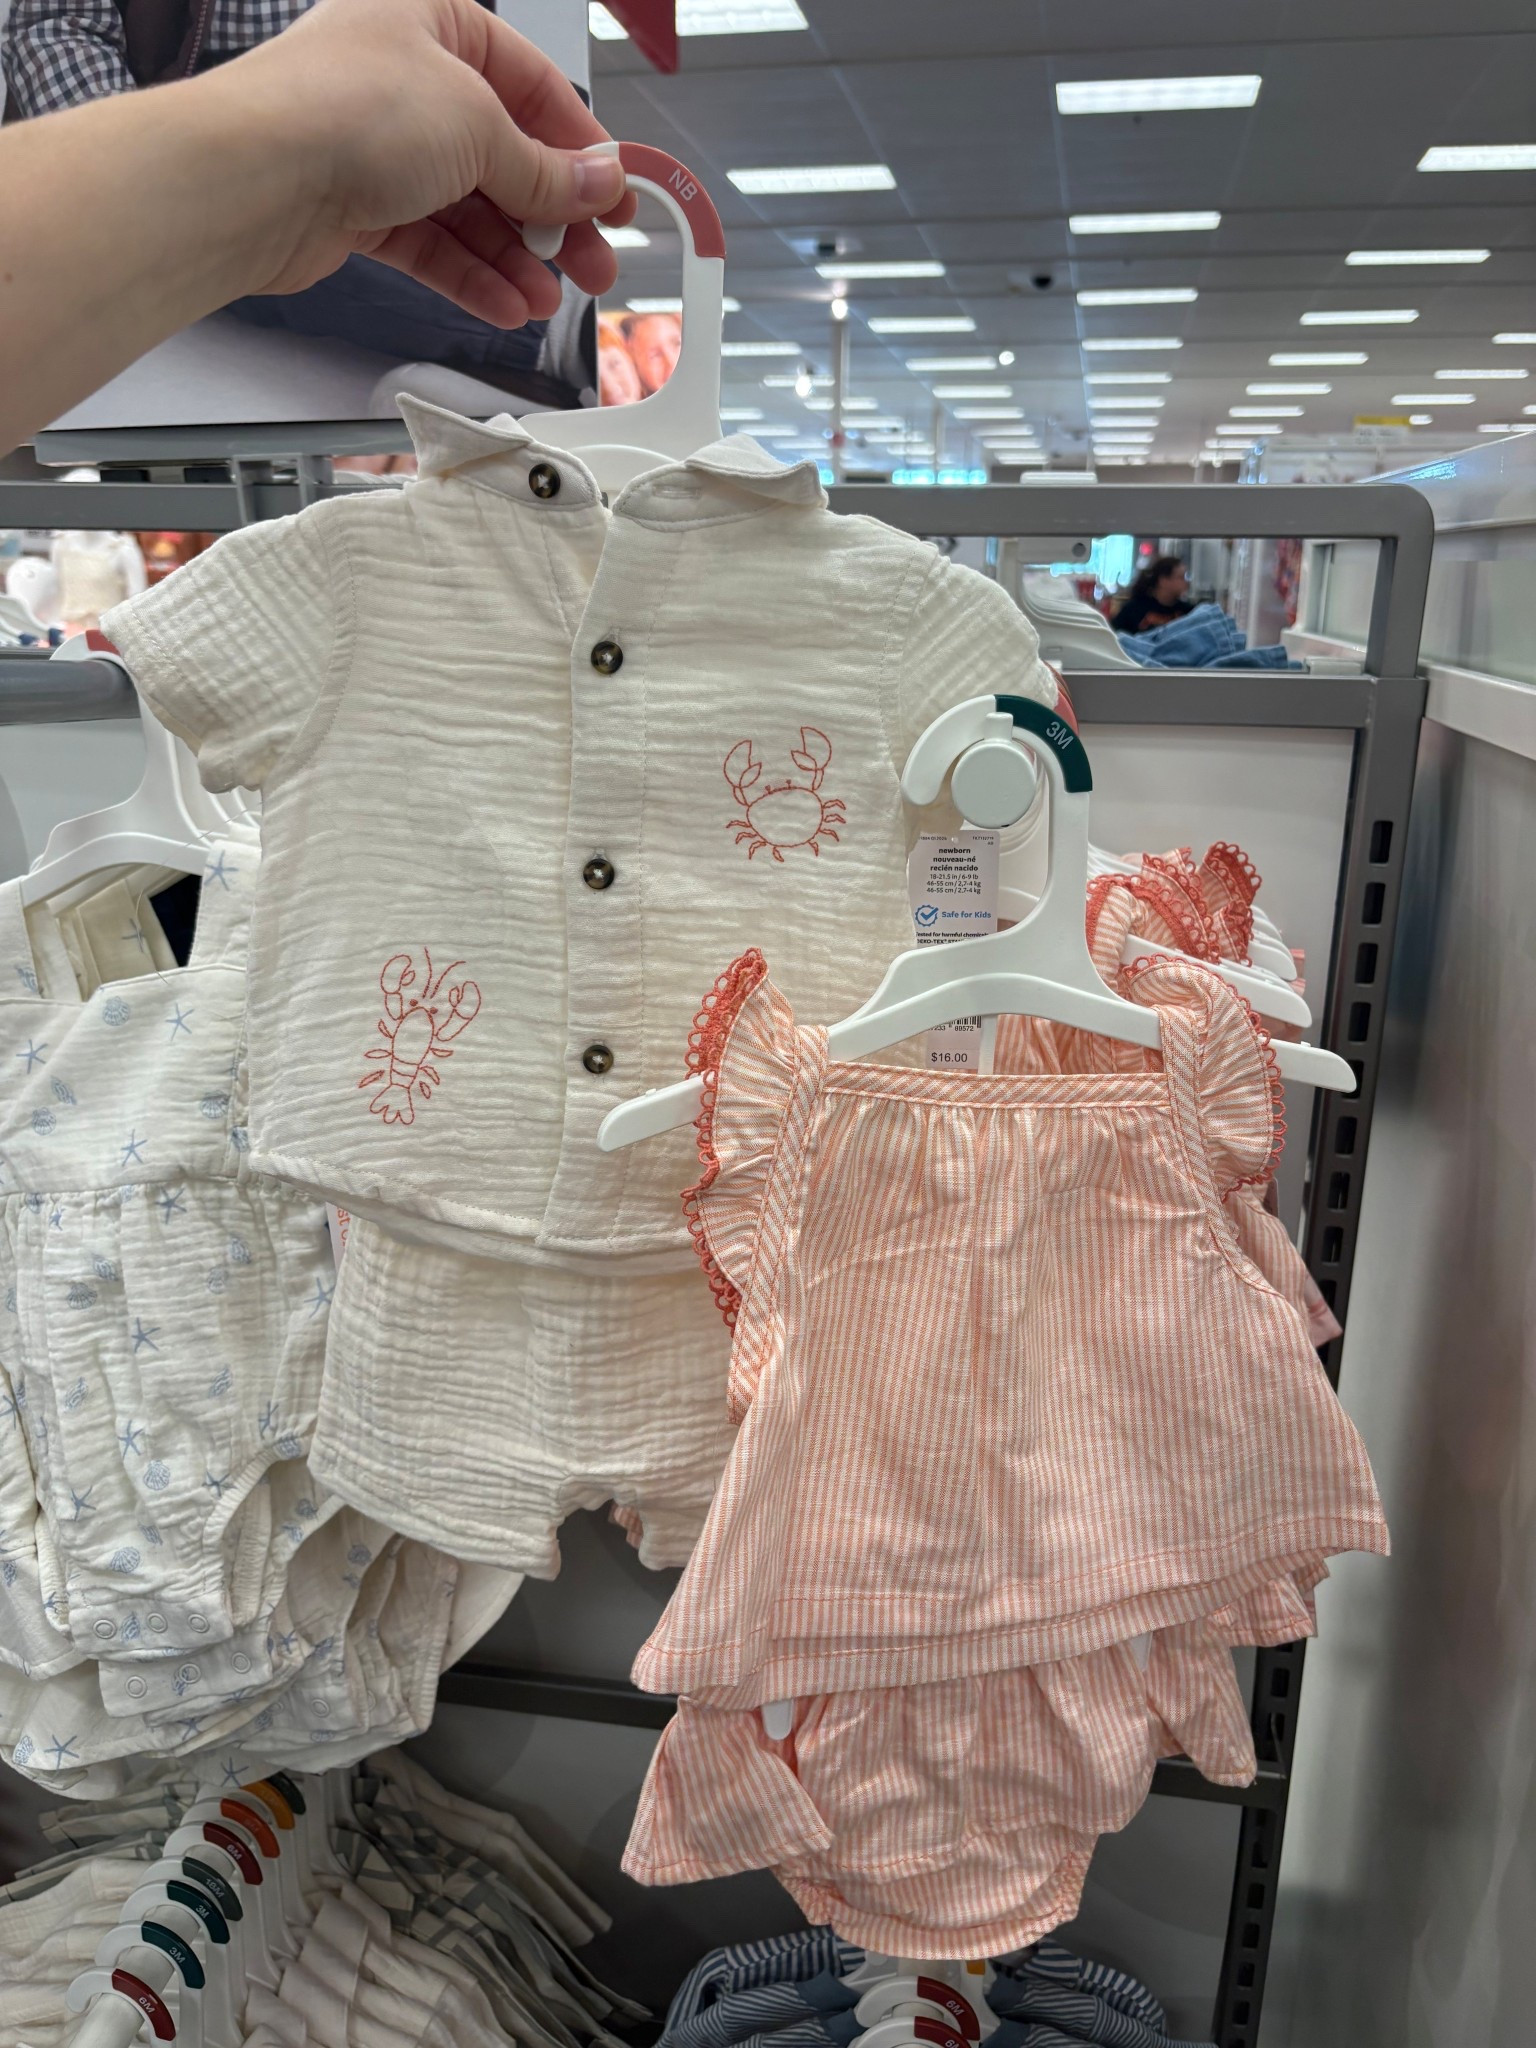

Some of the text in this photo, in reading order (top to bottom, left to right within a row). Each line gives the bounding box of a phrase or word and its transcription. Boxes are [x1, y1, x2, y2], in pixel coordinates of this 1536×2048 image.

[668, 168, 698, 202] NB
[1046, 721, 1074, 750] 3M
[933, 855, 976, 863] nouveau-né
[930, 864, 953, 872] recién
[974, 887, 981, 895] kg
[931, 1051, 968, 1063] $16.00
[195, 1904, 210, 1919] 3M
[169, 1946, 186, 1964] 3M
[138, 1996, 156, 2014] 6M
[945, 2000, 965, 2016] 6M
